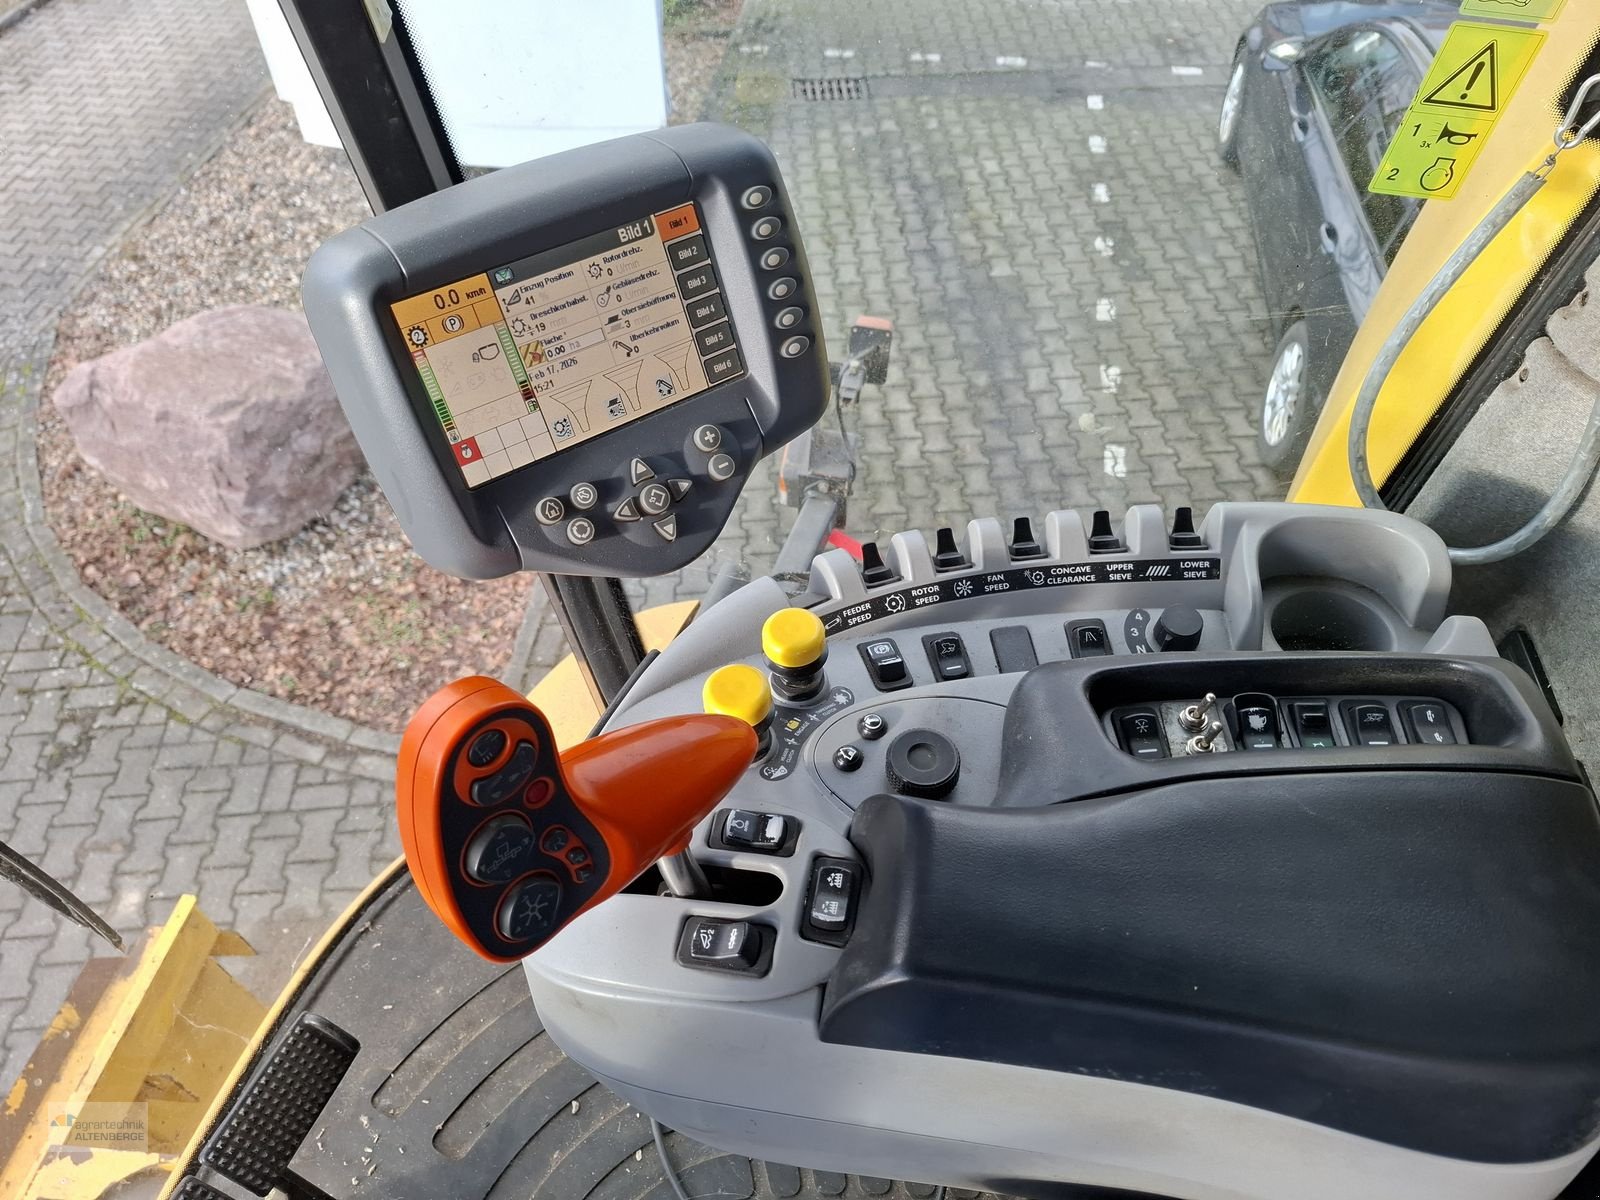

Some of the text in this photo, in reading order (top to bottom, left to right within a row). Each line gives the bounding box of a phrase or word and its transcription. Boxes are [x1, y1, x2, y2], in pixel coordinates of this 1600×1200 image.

[1413, 123, 1422, 137] 1
[1420, 140, 1431, 149] 3x
[1386, 167, 1400, 181] 2
[669, 219, 684, 229] Bild
[617, 219, 651, 243] Bild 1
[602, 246, 644, 265] Rotordrehz.
[678, 248, 692, 260] Bild
[606, 267, 613, 277] 0
[519, 269, 574, 295] Einzug Position
[687, 278, 700, 290] Bild
[433, 287, 487, 310] 0.0 km/h
[525, 295, 536, 306] 41
[616, 294, 622, 303] 0
[529, 295, 589, 321] Dreschkorbabst.
[696, 307, 709, 319] Bild
[536, 322, 547, 334] 19
[624, 319, 632, 329] 3
[705, 335, 718, 347] Bild
[547, 340, 581, 358] 0.00 ha
[633, 345, 640, 354] 0
[528, 357, 578, 382] Feb 17, 2026
[713, 362, 727, 374] Bild
[533, 379, 555, 395] 15:21
[1050, 565, 1092, 576] CONCAVE
[1106, 563, 1134, 572] UPPER
[1180, 561, 1210, 569] LOWER
[987, 573, 1005, 583] FAN
[1047, 575, 1096, 586] CLEARANCE
[1108, 572, 1133, 581] SIEVE
[1183, 571, 1207, 579] SIEVE
[911, 585, 940, 597] ROTOR
[984, 582, 1010, 592] SPEED
[915, 594, 940, 606] SPEED
[843, 602, 872, 618] FEEDER
[847, 612, 872, 626] SPEED
[1135, 612, 1143, 621] 4
[1130, 627, 1139, 637] 3
[1135, 644, 1147, 655] N
